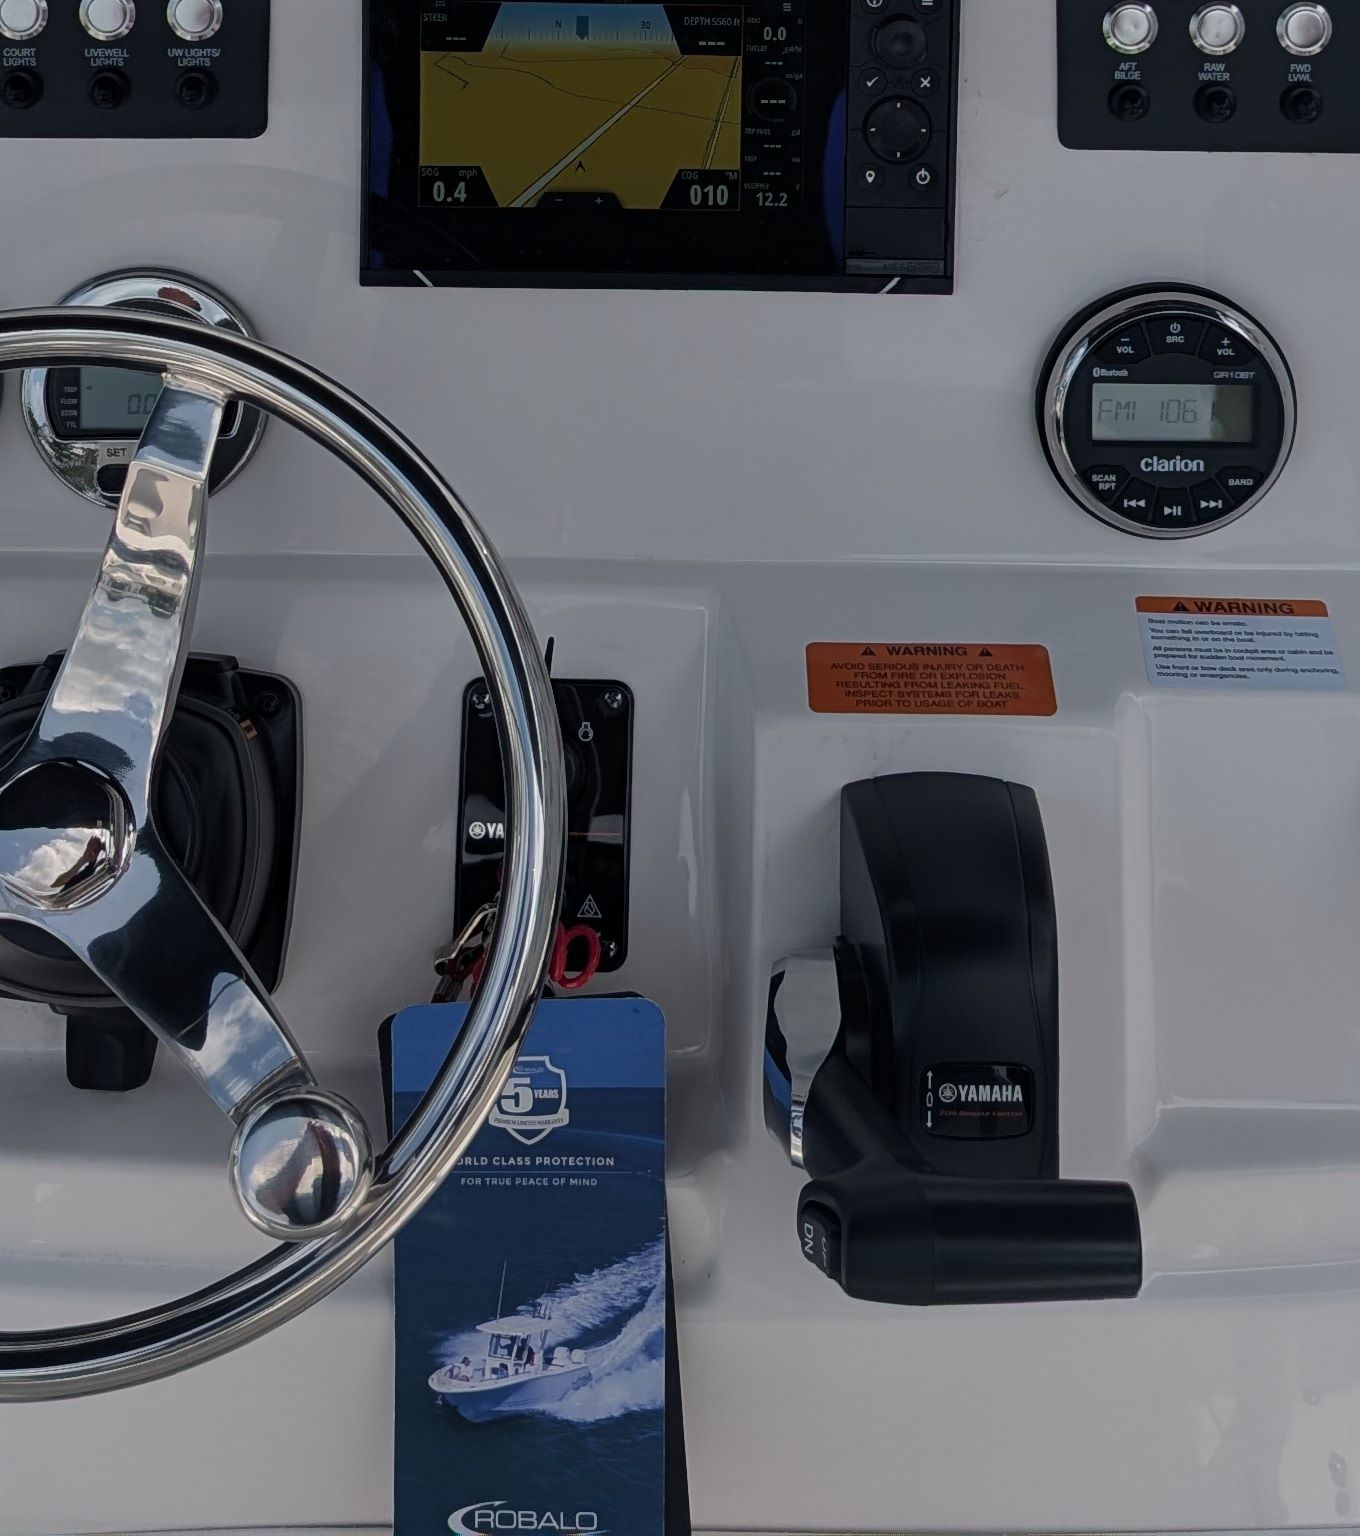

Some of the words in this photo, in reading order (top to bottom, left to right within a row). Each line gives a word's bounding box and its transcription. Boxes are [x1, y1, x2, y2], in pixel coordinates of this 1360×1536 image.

[640, 21, 650, 29] 30
[684, 17, 710, 26] DEPTH
[763, 26, 786, 41] 0.0
[3, 48, 36, 57] COURT
[84, 48, 130, 57] LIVEWELL
[167, 48, 183, 57] UW
[185, 48, 221, 57] LIGHTS/
[3, 58, 37, 67] LIGHTS
[91, 58, 124, 67] LIGHTS
[177, 58, 211, 66] LIGHTS
[1119, 62, 1137, 71] AFT
[1203, 63, 1226, 71] RAW
[1290, 64, 1311, 72] FWD
[1114, 71, 1141, 80] BILGE
[1197, 72, 1230, 81] WATER
[1288, 73, 1312, 82] LVWL
[420, 167, 440, 176] SOG
[681, 171, 699, 180] COG
[433, 181, 467, 203] 0.4
[689, 184, 729, 206] 010
[756, 192, 788, 207] 12.2
[1116, 345, 1135, 354] VOL
[1216, 348, 1236, 356] VOL
[107, 448, 127, 457] SET
[1091, 474, 1116, 482] SCAN
[1228, 478, 1253, 486] BAND
[1193, 601, 1295, 614] WARNING
[886, 646, 967, 656] WARNING
[868, 663, 919, 671] SERIOUS
[922, 663, 964, 671] INJURY
[986, 664, 1024, 672] DEATH
[854, 672, 888, 680] FROM
[891, 672, 917, 680] FIRE
[919, 672, 937, 680] OR
[836, 681, 901, 689] RESULTING
[904, 681, 938, 689] FROM
[844, 690, 893, 698] INSPECT
[897, 690, 952, 699] SYSTEMS
[955, 691, 980, 699] FOR
[982, 691, 1020, 699] LEAKS
[855, 699, 891, 707] PRIOR
[915, 700, 954, 708] USAGE
[957, 700, 974, 708] OF
[977, 700, 1008, 708] BOAT
[500, 1077, 533, 1113] 5
[534, 1089, 559, 1099] YEARS
[958, 1084, 1024, 1102] YAMAHA
[492, 1157, 530, 1166] CLASS
[535, 1157, 615, 1166] PROTECTION
[552, 1178, 566, 1186] OF
[570, 1178, 598, 1186] MIND
[804, 1223, 814, 1255] DN
[474, 1509, 597, 1530] ROBALO
